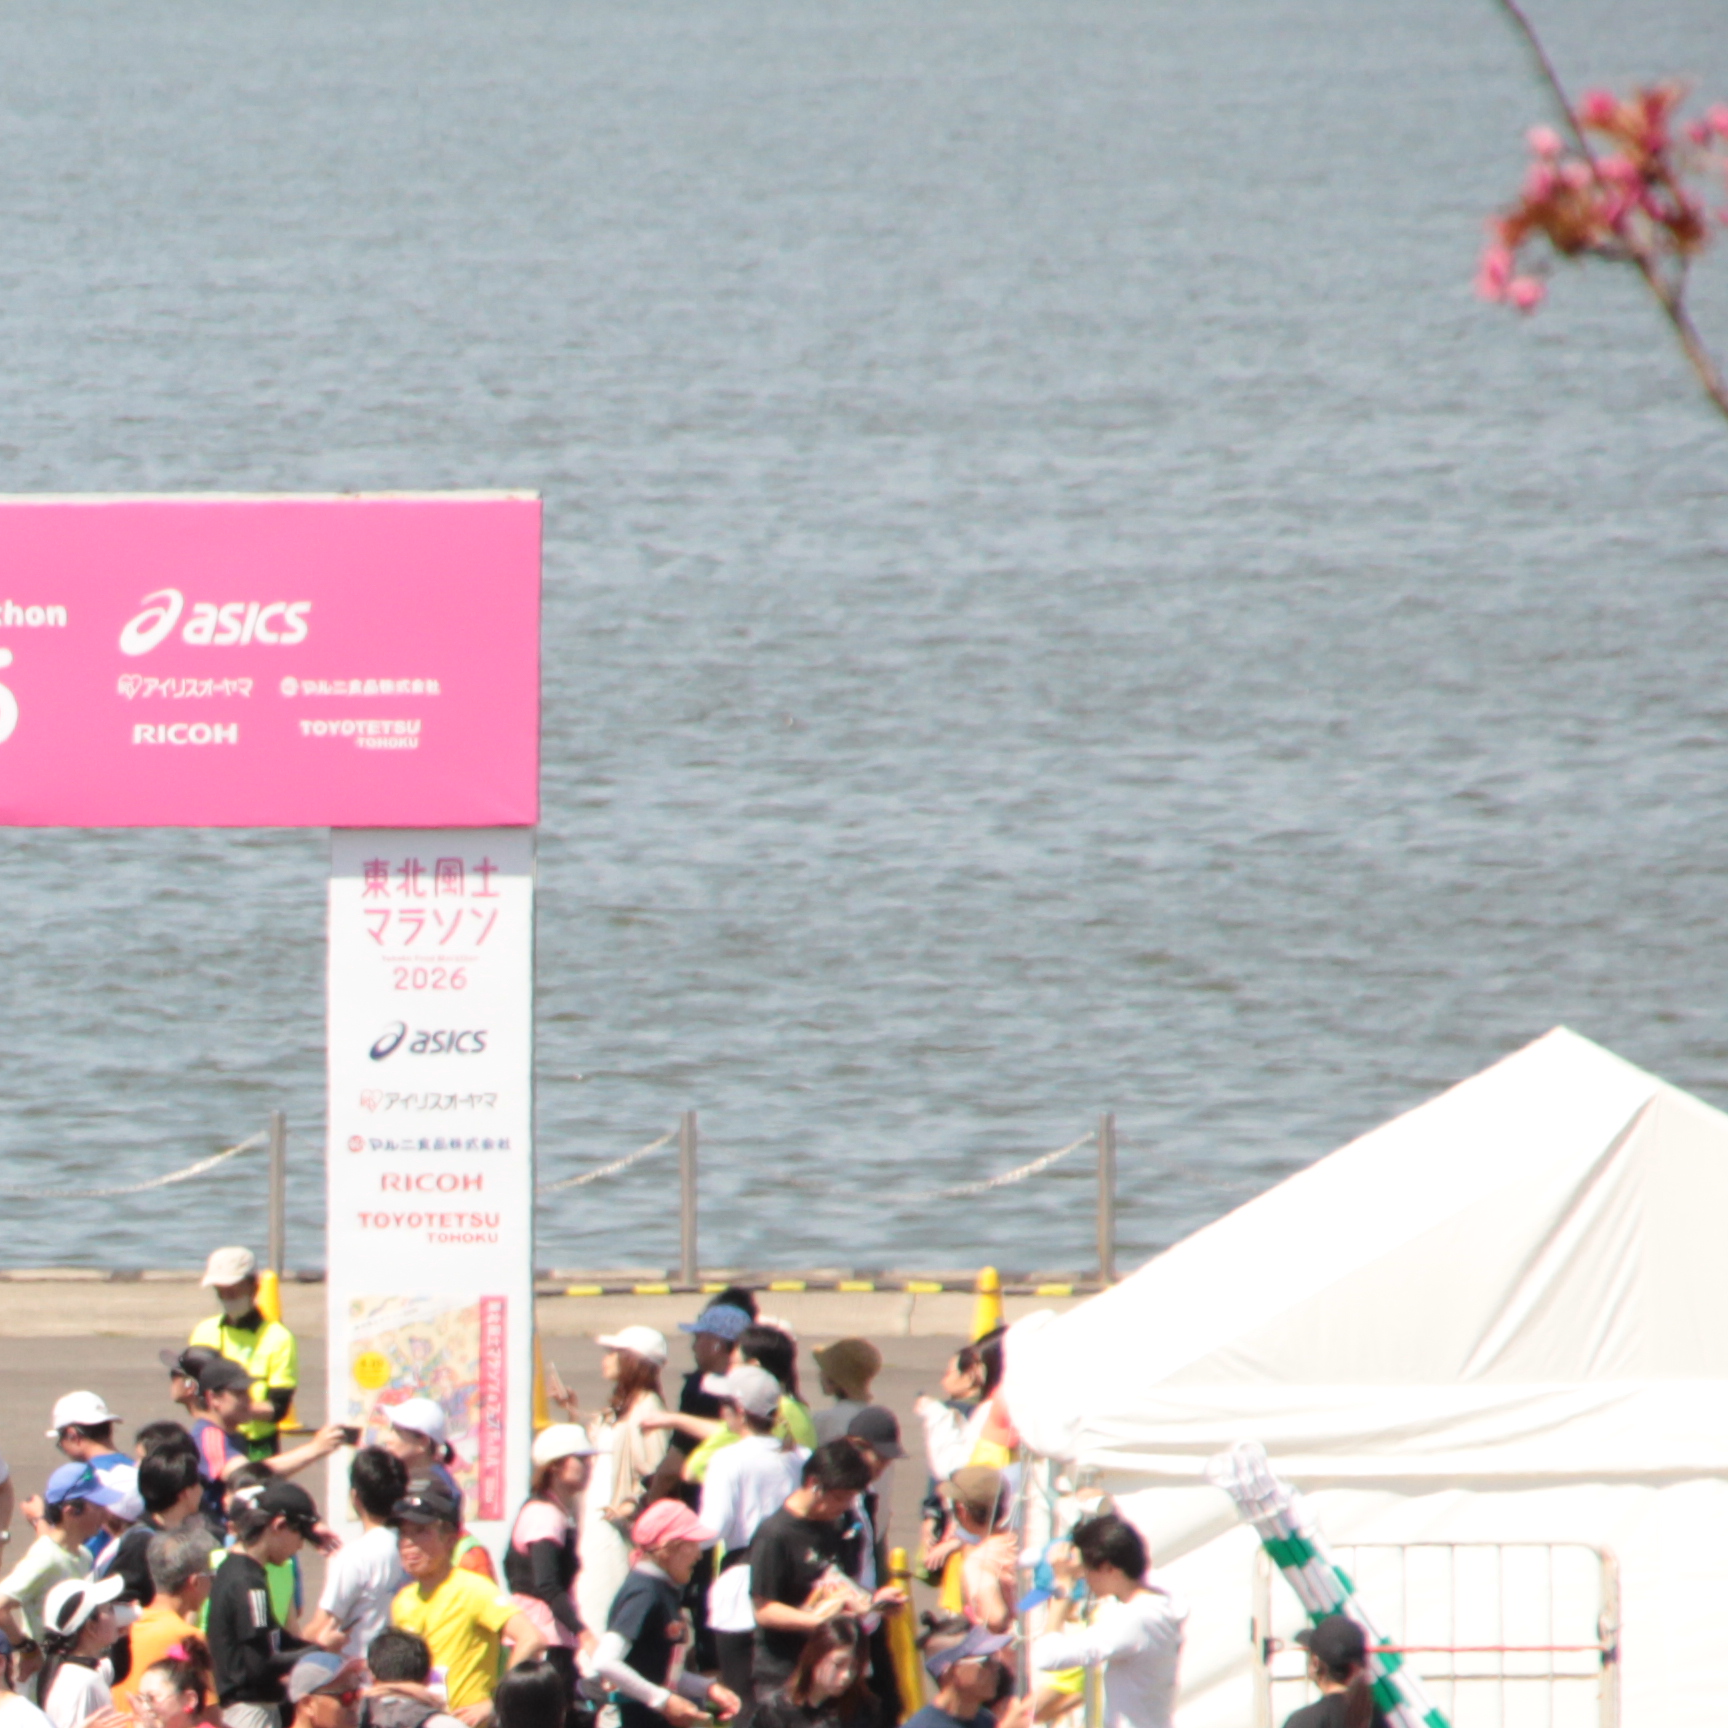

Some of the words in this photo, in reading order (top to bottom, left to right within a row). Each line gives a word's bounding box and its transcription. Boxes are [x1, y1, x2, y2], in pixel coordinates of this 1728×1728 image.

[142, 676, 254, 698] アイリスオーヤマ
[132, 722, 239, 745] RICOH
[299, 718, 422, 737] TOYOTETSU
[361, 856, 501, 899] 東北風土
[362, 907, 500, 947] マラソン
[392, 965, 468, 992] 2026
[384, 1092, 498, 1111] アイリスオーヤマ
[380, 1172, 484, 1193] RICOH
[357, 1211, 501, 1229] TOYOTETSU
[427, 1231, 499, 1244] TOHOKU
